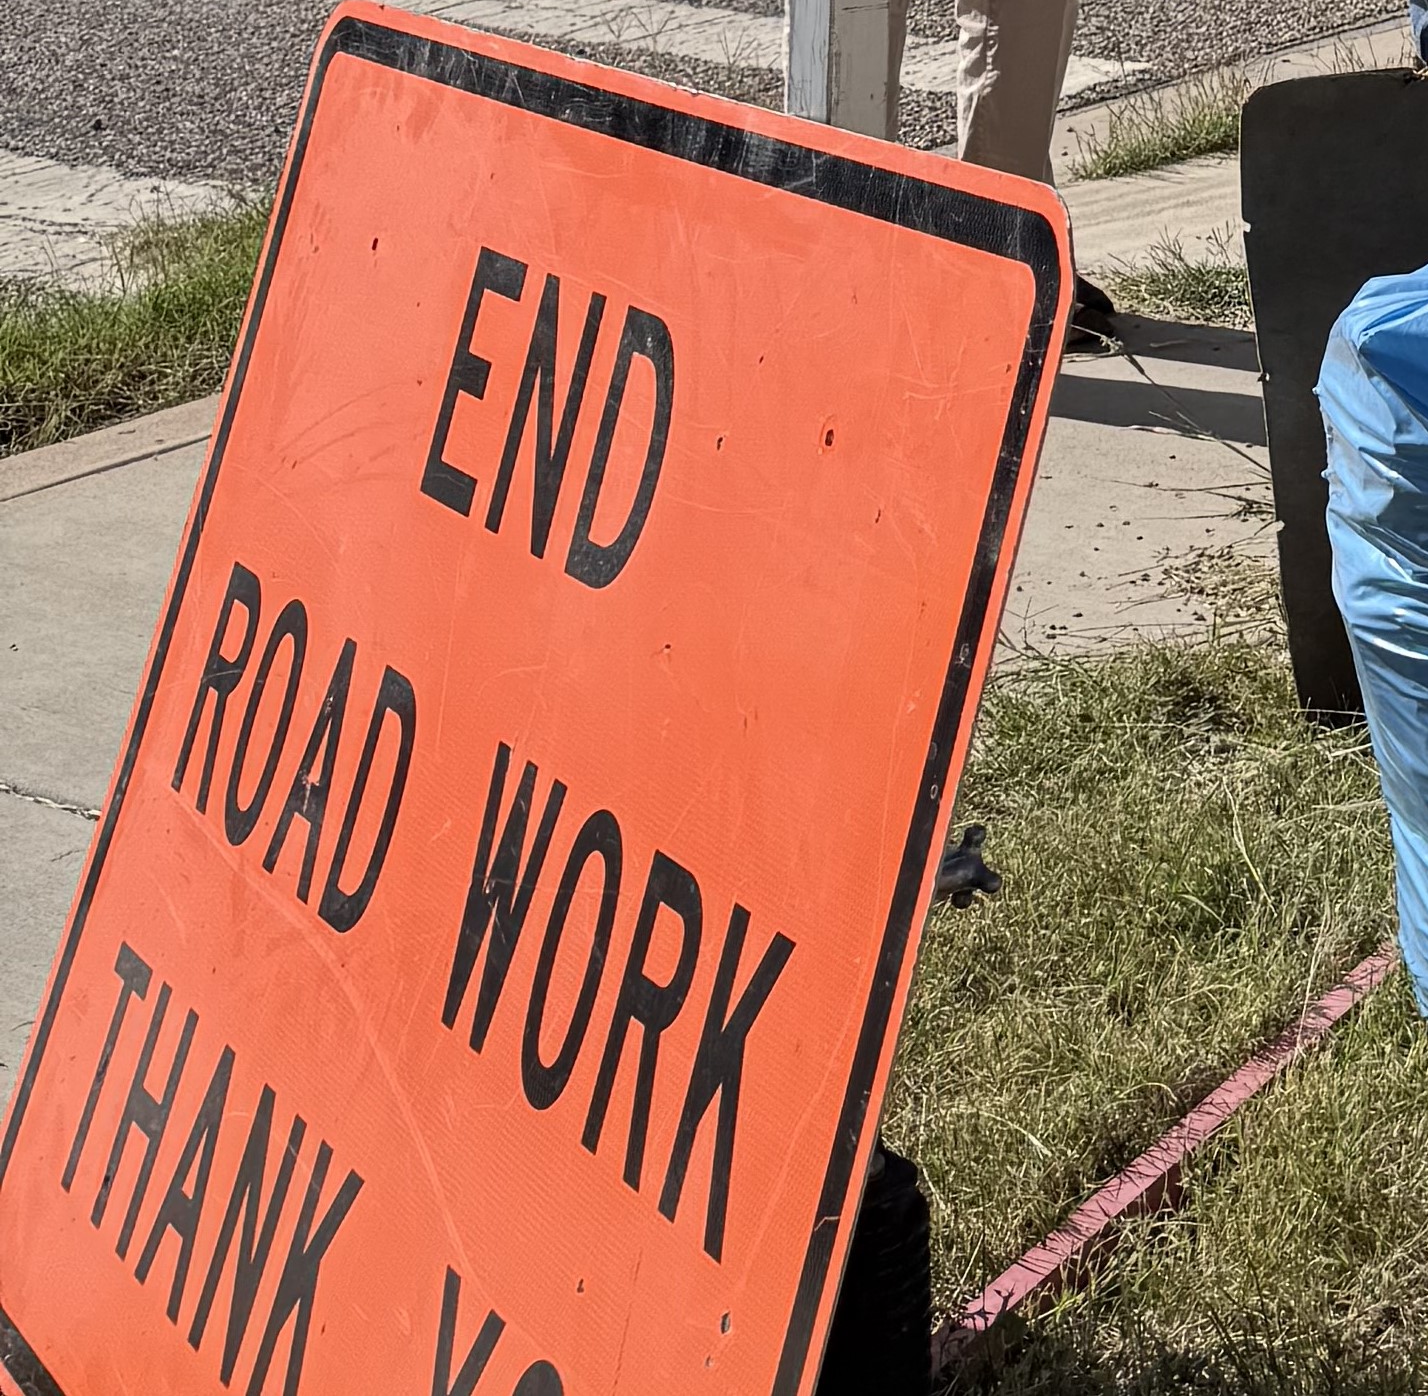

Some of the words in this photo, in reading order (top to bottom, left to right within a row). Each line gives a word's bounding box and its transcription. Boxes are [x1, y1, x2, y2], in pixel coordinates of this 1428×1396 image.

[420, 245, 674, 590] END
[170, 560, 415, 935] ROAD
[441, 740, 797, 1266] WORK
[60, 940, 366, 1396] THANK
